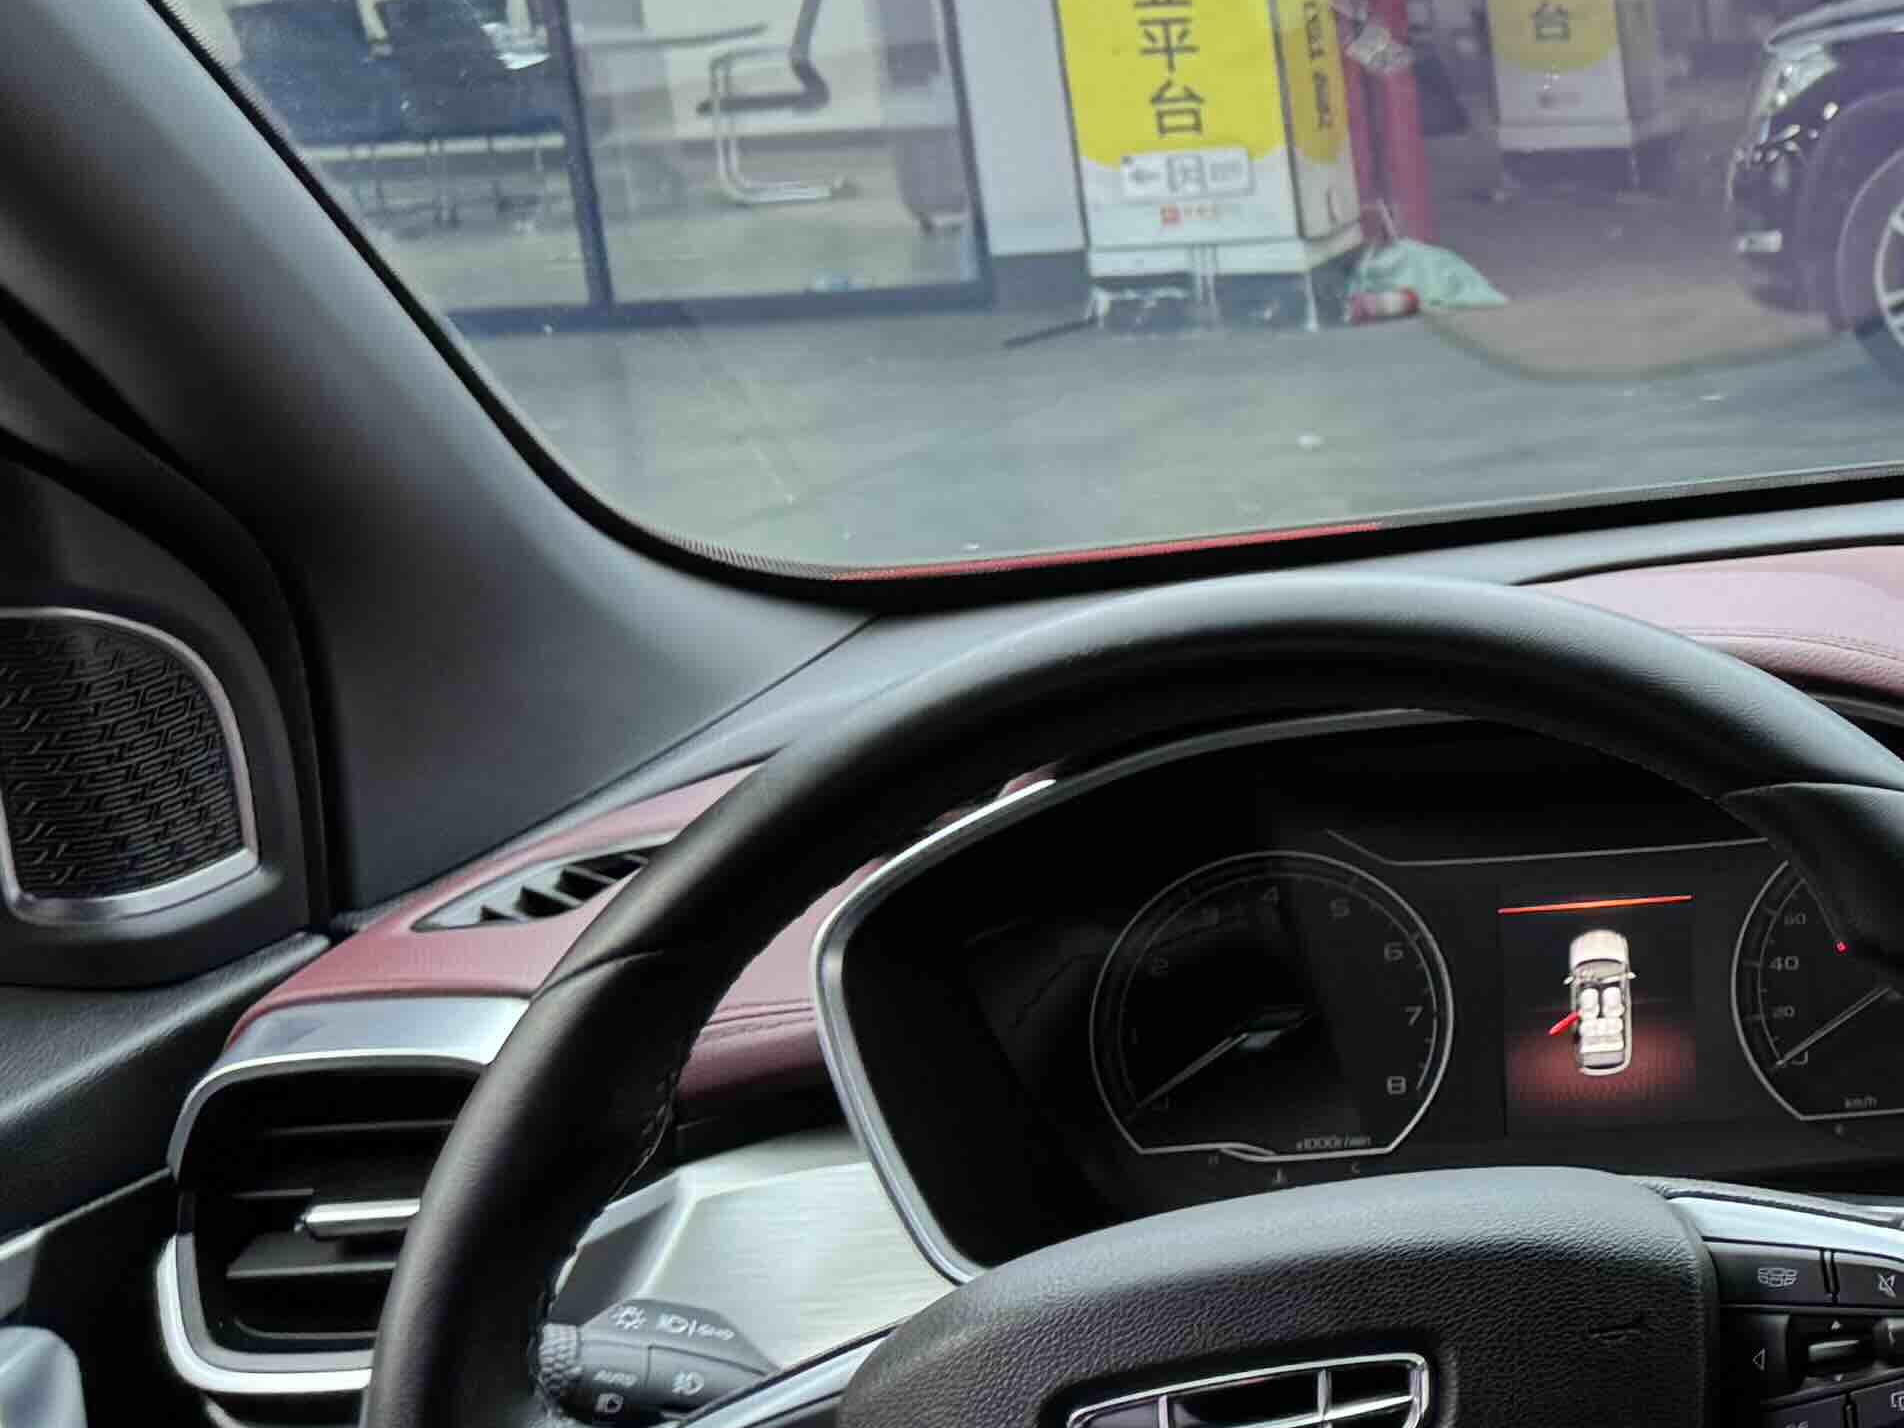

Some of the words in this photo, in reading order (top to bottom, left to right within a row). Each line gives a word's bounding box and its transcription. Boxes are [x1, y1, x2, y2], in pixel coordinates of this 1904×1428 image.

[1384, 943, 1404, 962] 6
[1769, 956, 1800, 972] 40
[1405, 1006, 1424, 1026] 7
[1386, 1076, 1408, 1096] 8
